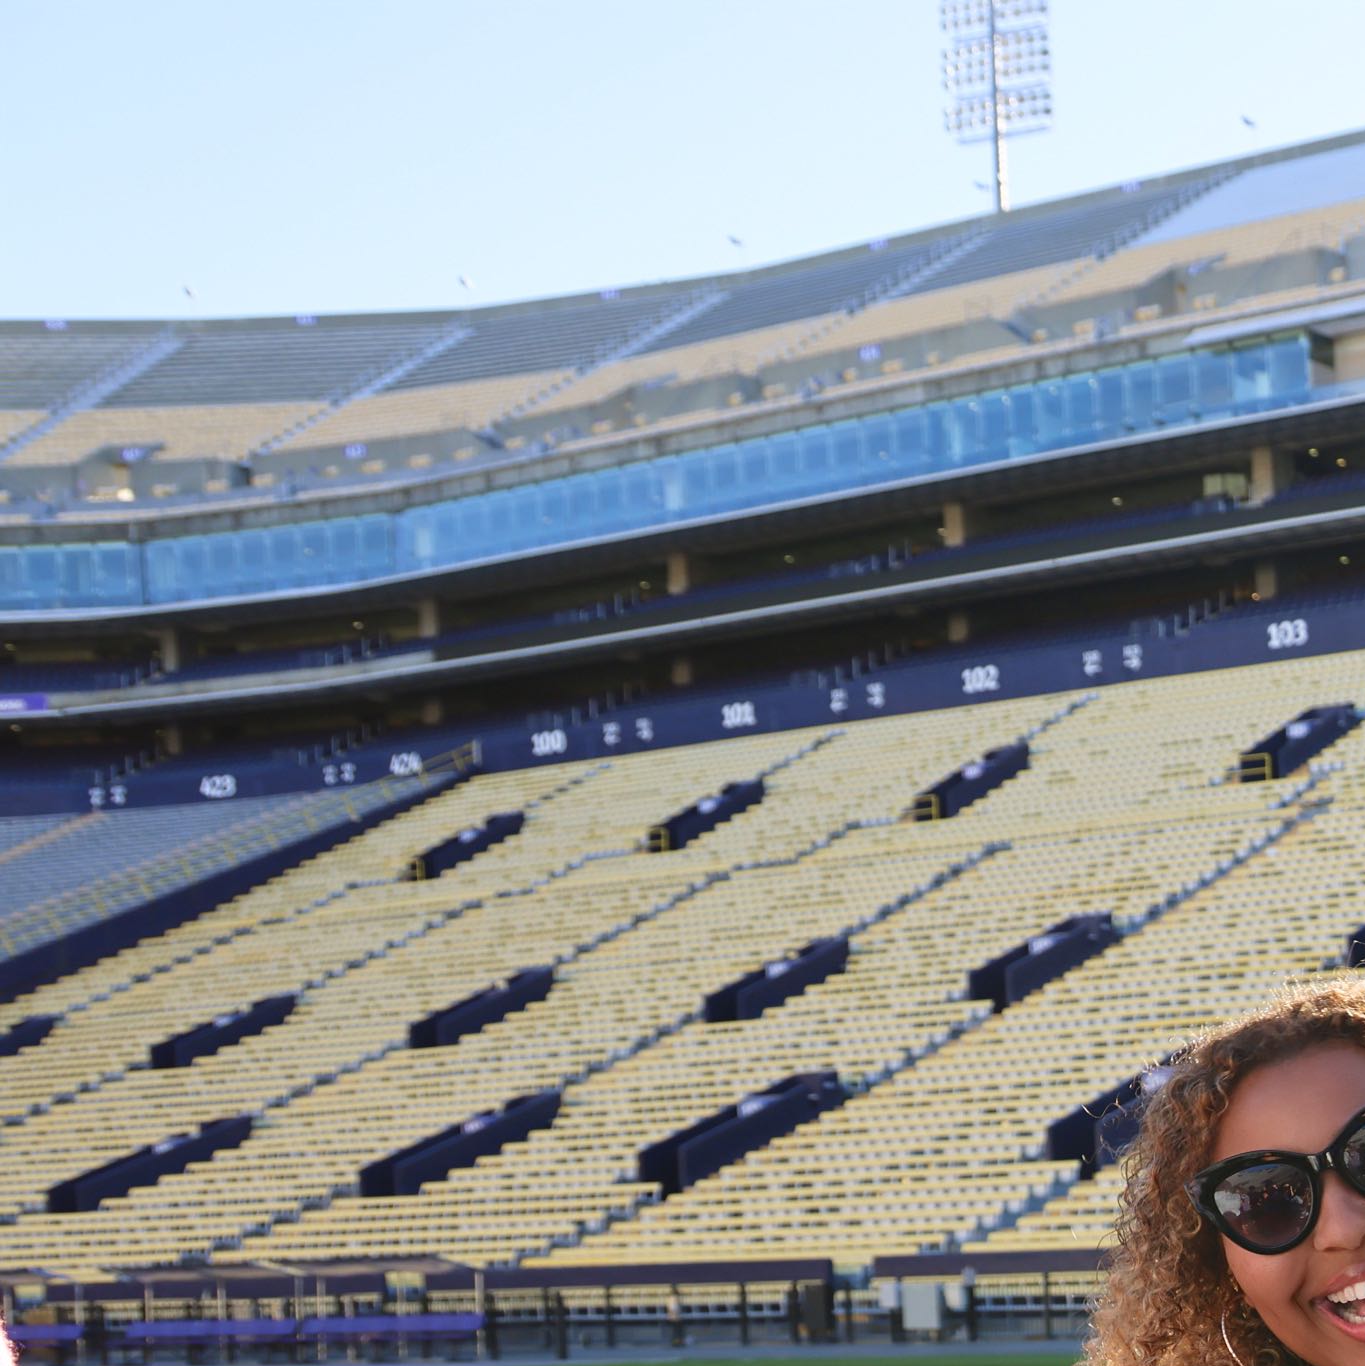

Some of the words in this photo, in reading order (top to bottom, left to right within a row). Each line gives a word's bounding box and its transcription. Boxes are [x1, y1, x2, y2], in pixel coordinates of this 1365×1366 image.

[1267, 619, 1309, 649] 103
[961, 664, 1000, 694] 102
[721, 701, 756, 729] 101
[531, 729, 567, 756] 100
[199, 774, 237, 798] 423
